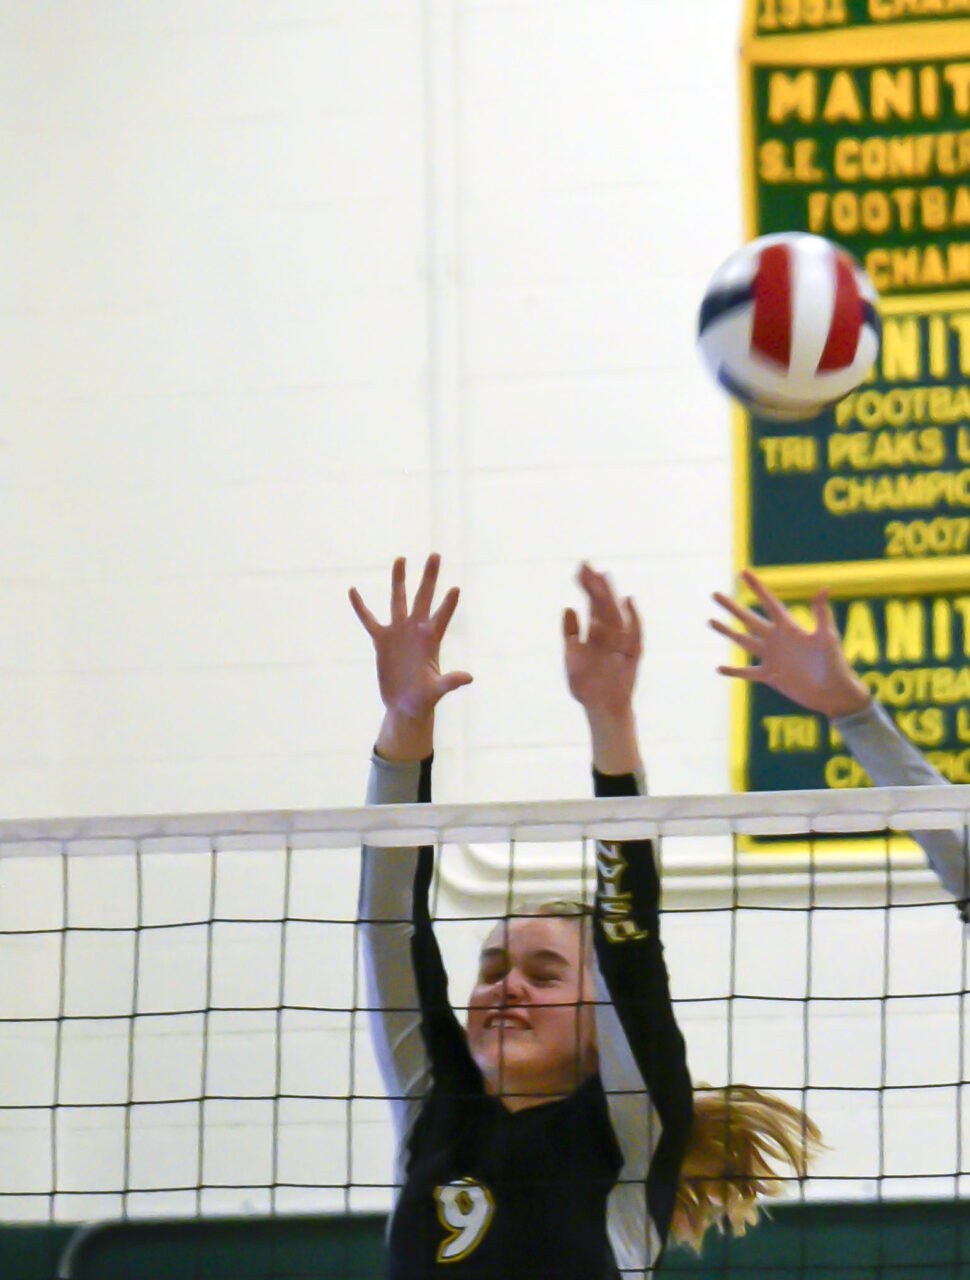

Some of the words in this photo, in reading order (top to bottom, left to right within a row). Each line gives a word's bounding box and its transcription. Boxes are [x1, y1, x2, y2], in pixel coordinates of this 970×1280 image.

[759, 436, 819, 474] TRI
[828, 427, 945, 471] PEAKS
[763, 715, 821, 752] TRI
[434, 1176, 495, 1263] 9
